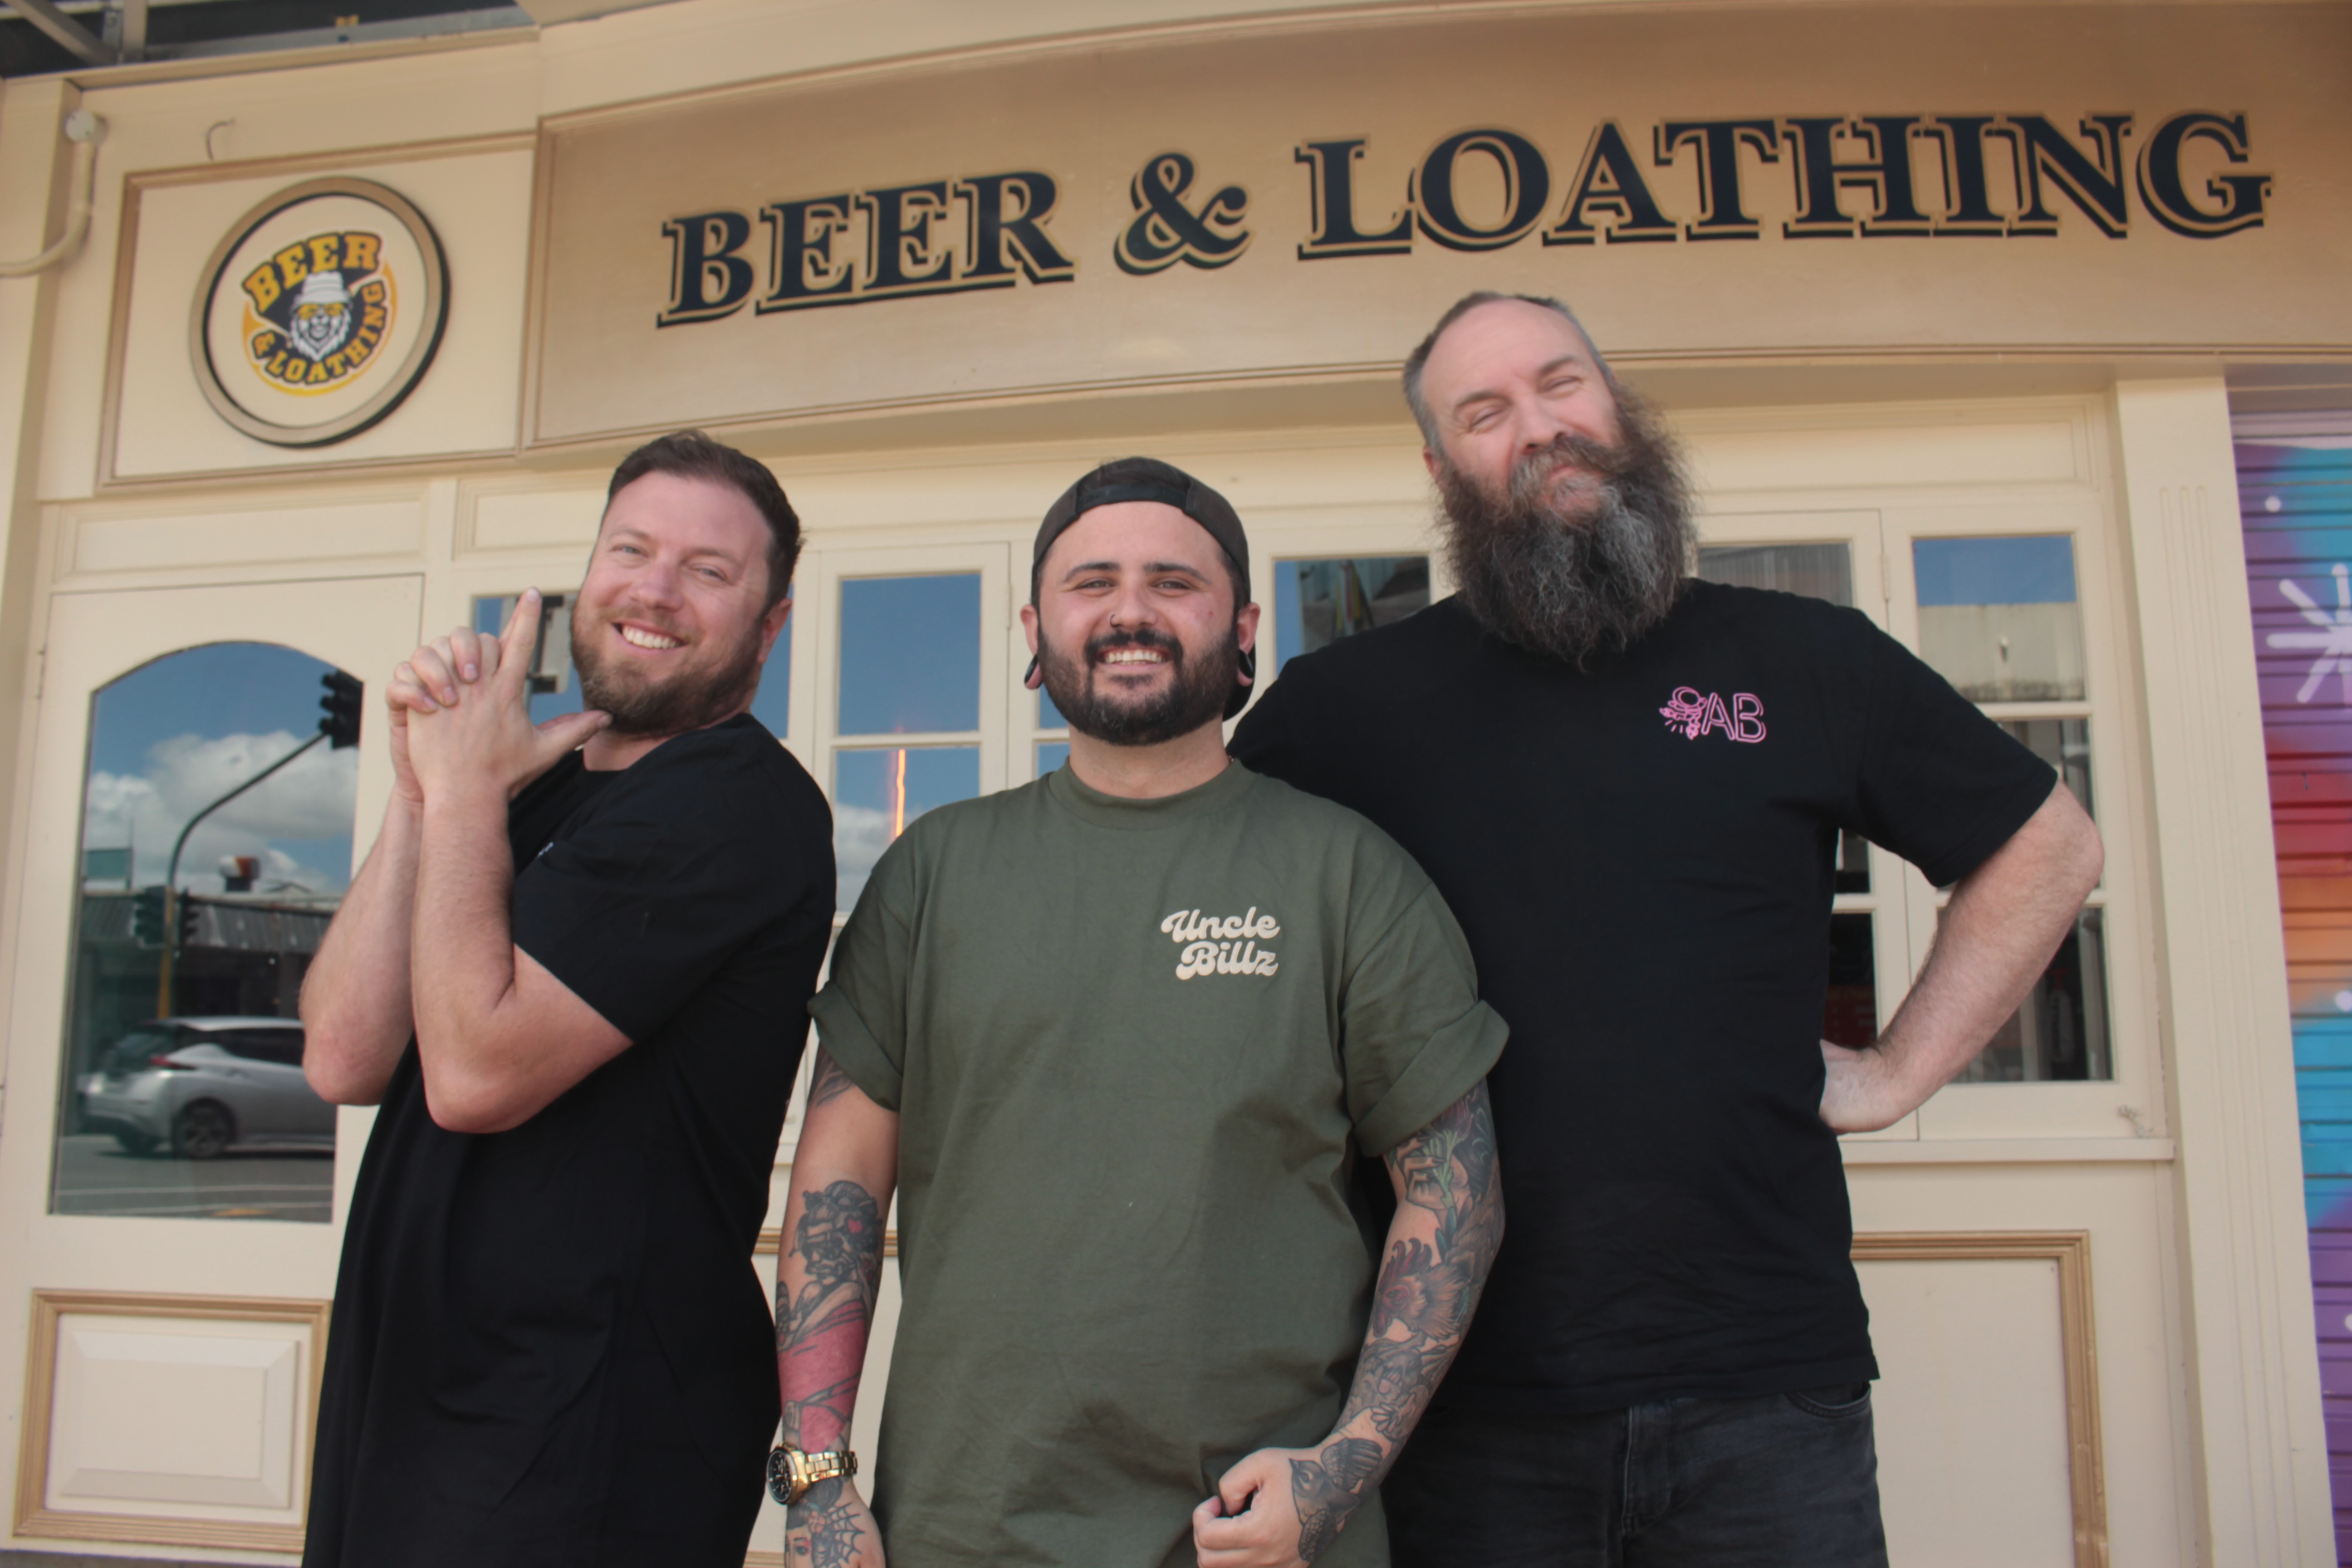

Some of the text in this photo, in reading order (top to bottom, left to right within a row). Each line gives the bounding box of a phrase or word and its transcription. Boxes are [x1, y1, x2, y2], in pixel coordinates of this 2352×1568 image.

[657, 112, 2273, 328] BEER & LOATHING
[243, 233, 380, 313] BEER
[253, 282, 386, 382] & LOATHING
[1161, 906, 1280, 943] Uncle
[1176, 941, 1279, 980] Billz
